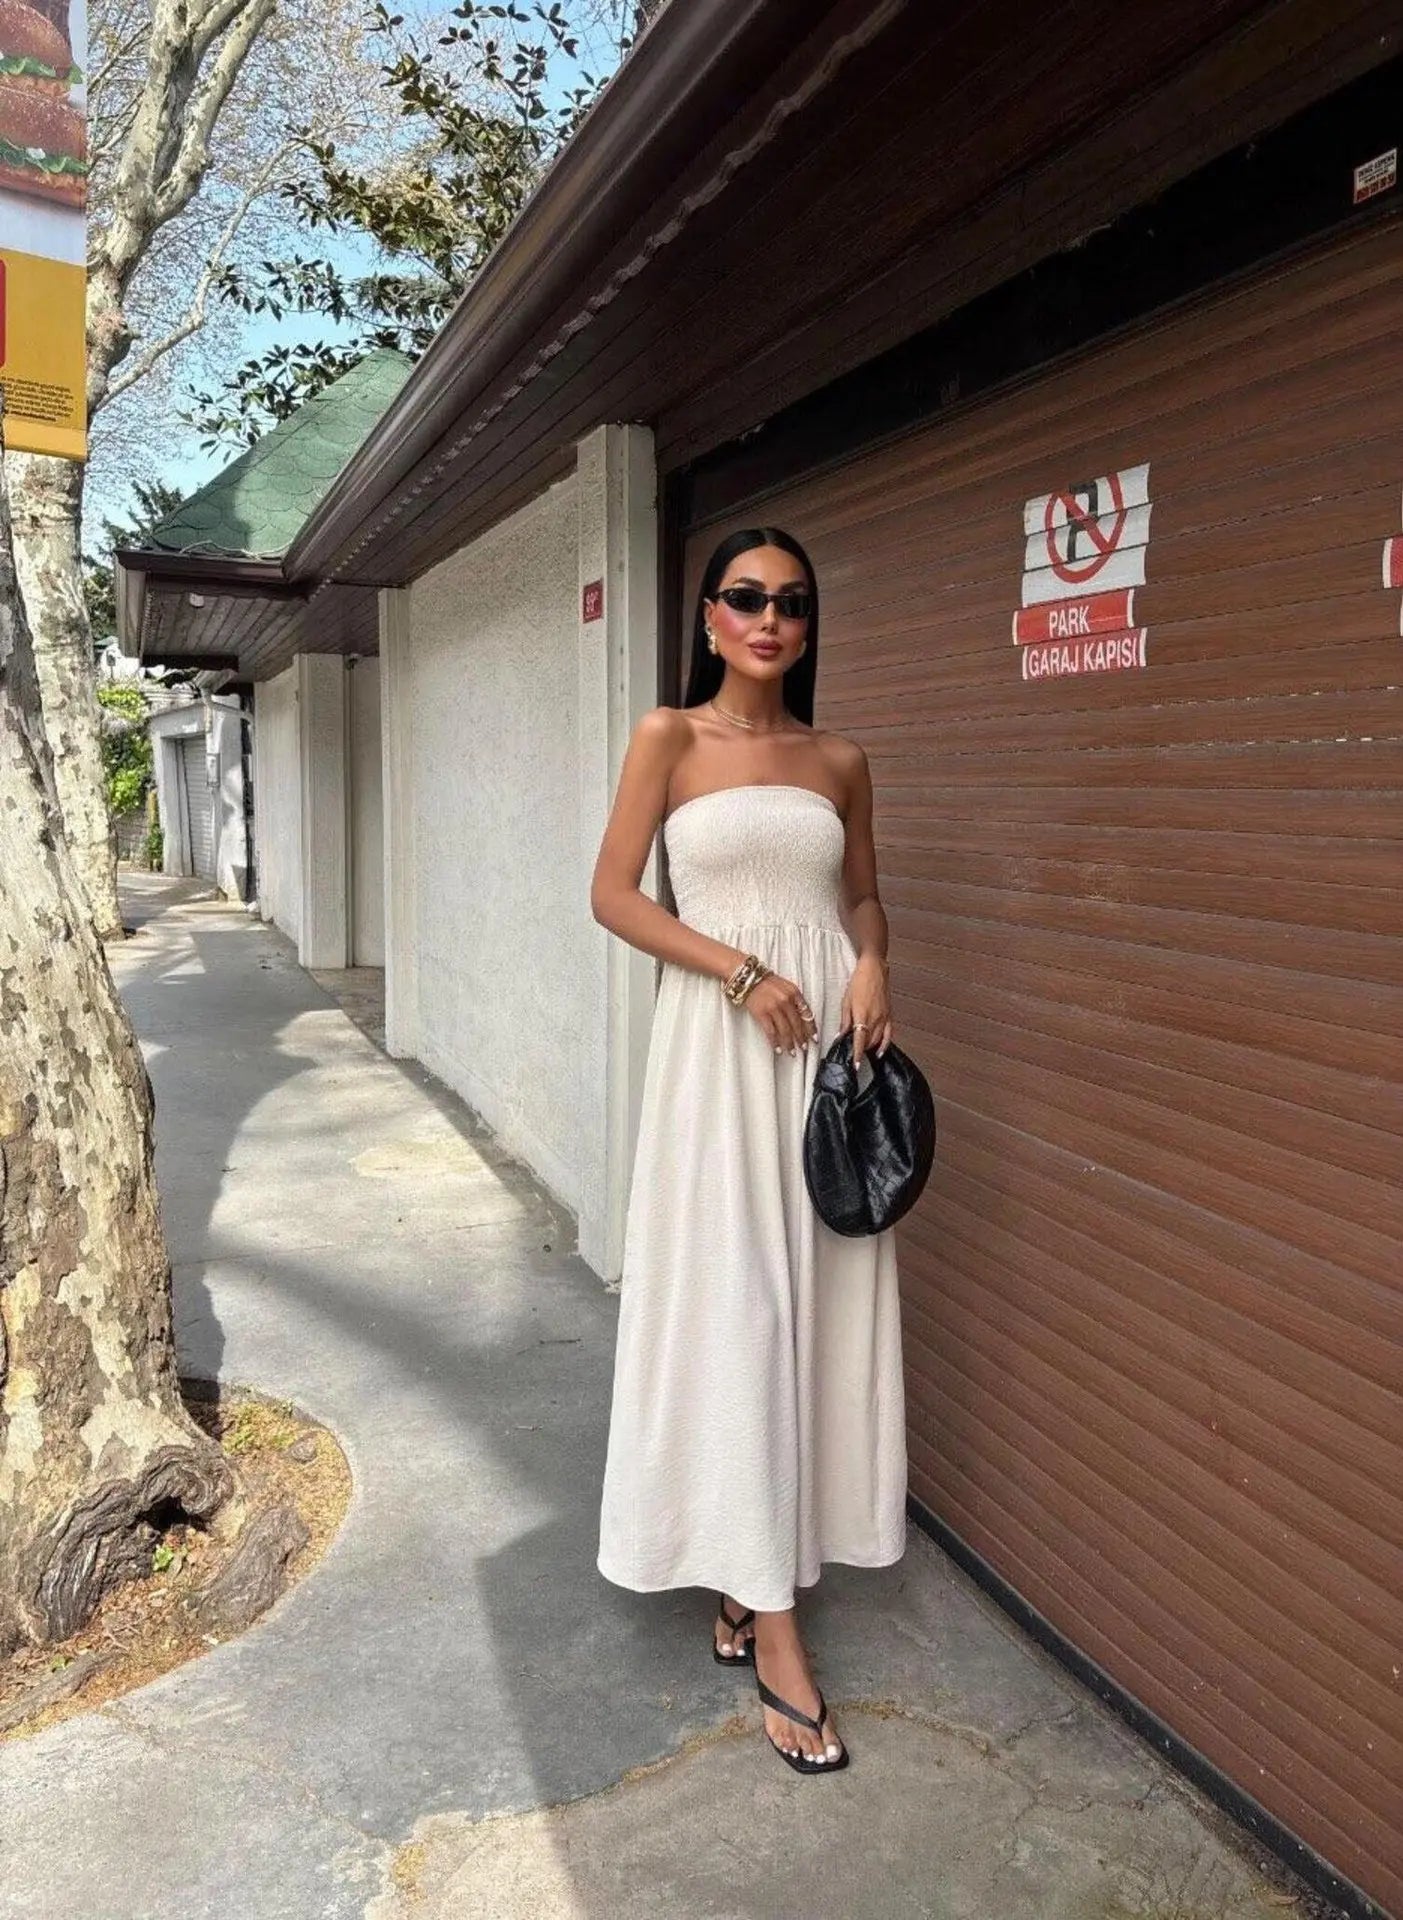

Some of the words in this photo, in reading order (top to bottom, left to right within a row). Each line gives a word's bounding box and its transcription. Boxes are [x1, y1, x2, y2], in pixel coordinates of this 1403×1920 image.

[1049, 605, 1091, 638] PARK
[1028, 645, 1079, 677] GARAJ
[1083, 637, 1137, 671] KAPISI
